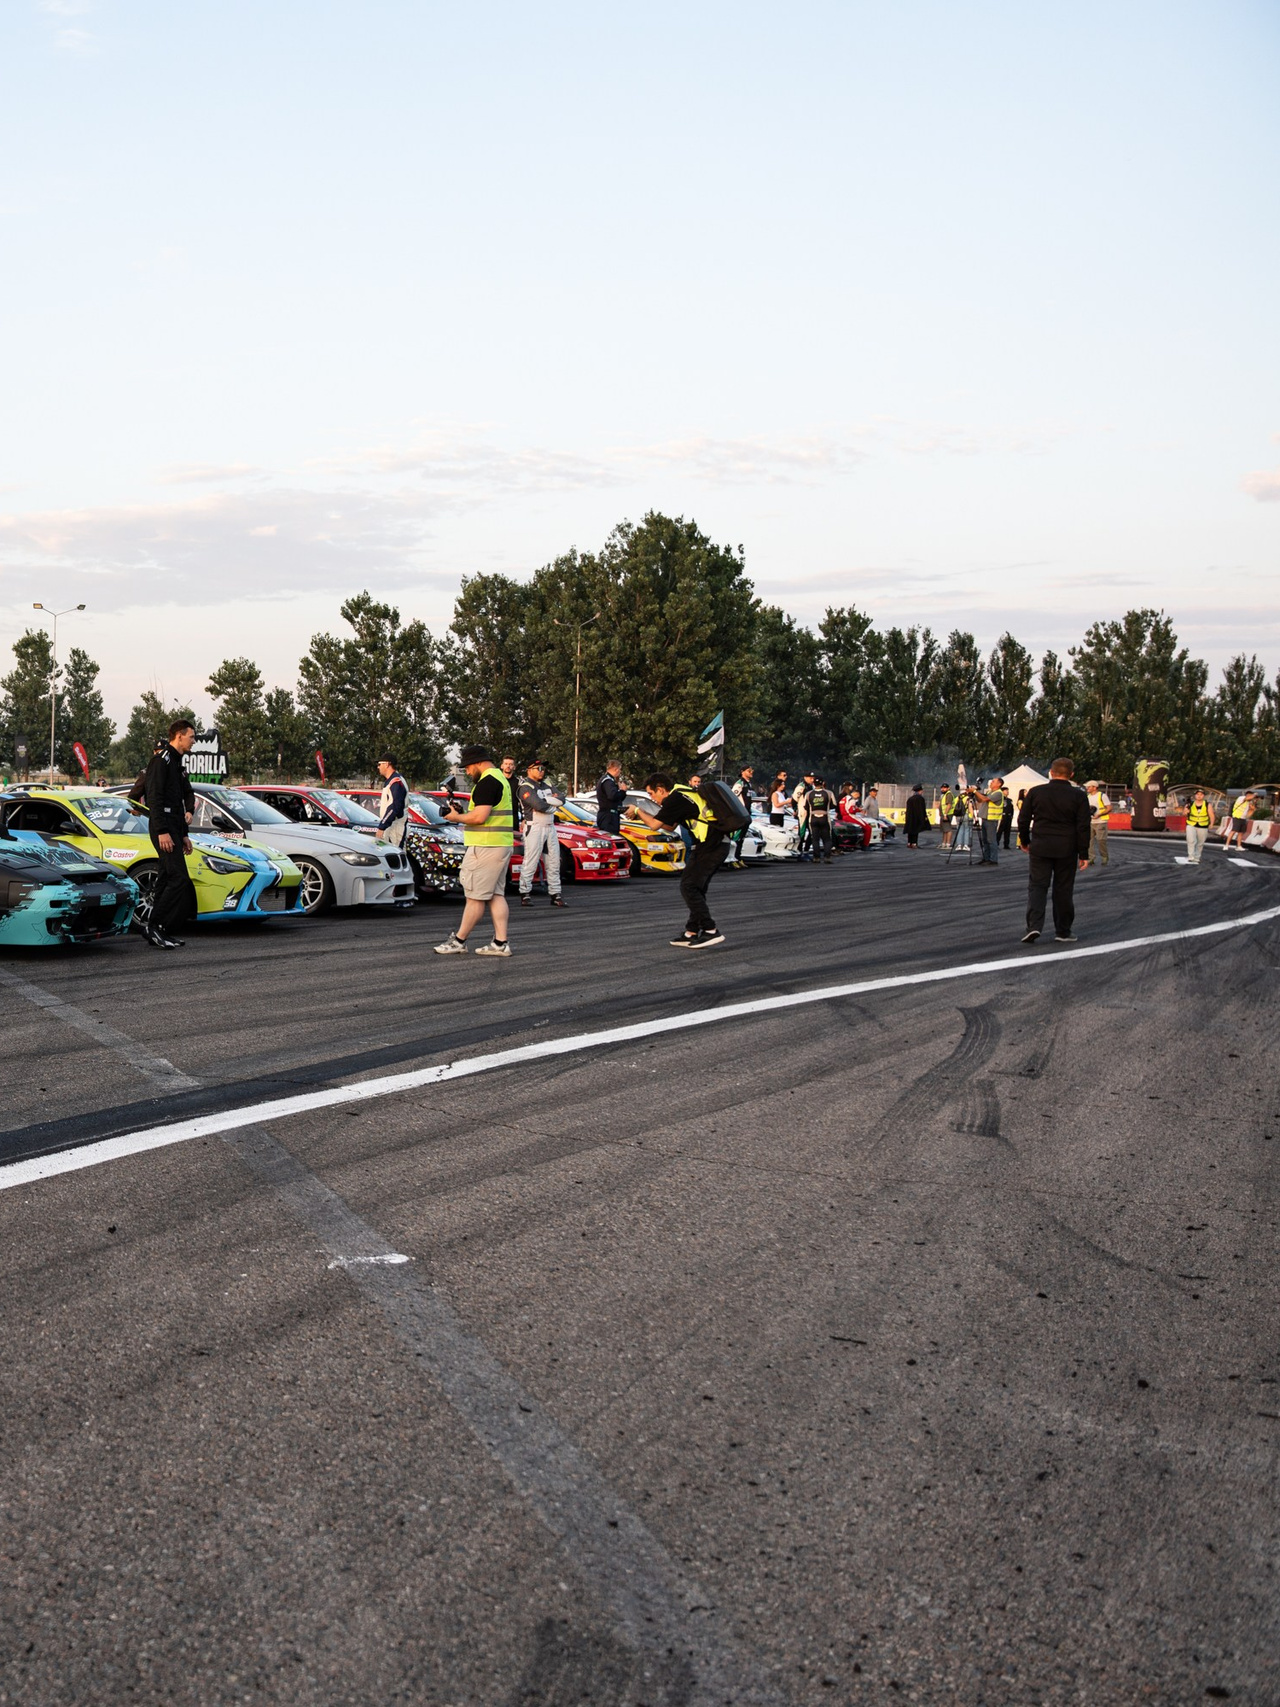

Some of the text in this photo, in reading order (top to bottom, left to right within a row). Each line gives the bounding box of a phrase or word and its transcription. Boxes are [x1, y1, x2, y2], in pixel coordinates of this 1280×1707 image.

[182, 754, 227, 774] GORILLA
[112, 851, 136, 859] Castrol
[223, 899, 238, 908] 38
